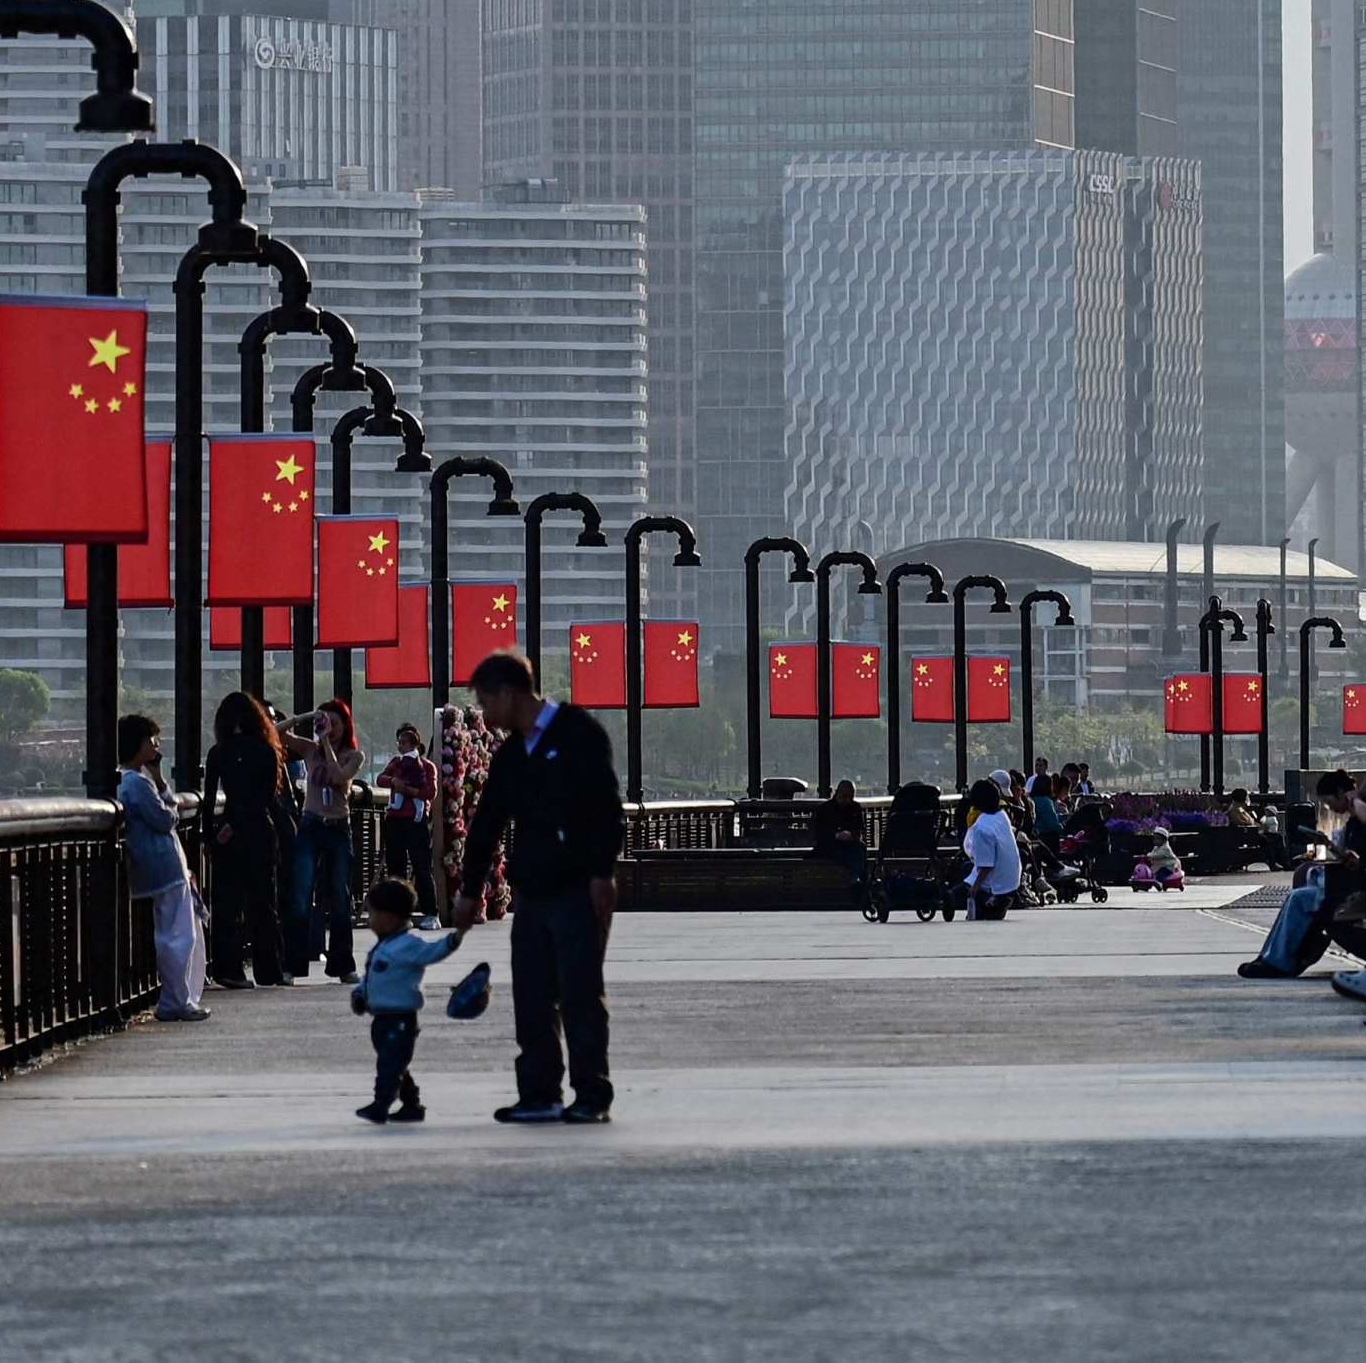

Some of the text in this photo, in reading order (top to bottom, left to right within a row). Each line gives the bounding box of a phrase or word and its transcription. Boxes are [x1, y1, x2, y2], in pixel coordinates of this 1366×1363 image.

[275, 40, 333, 73] 兴业银行
[1090, 174, 1116, 194] CSSC
